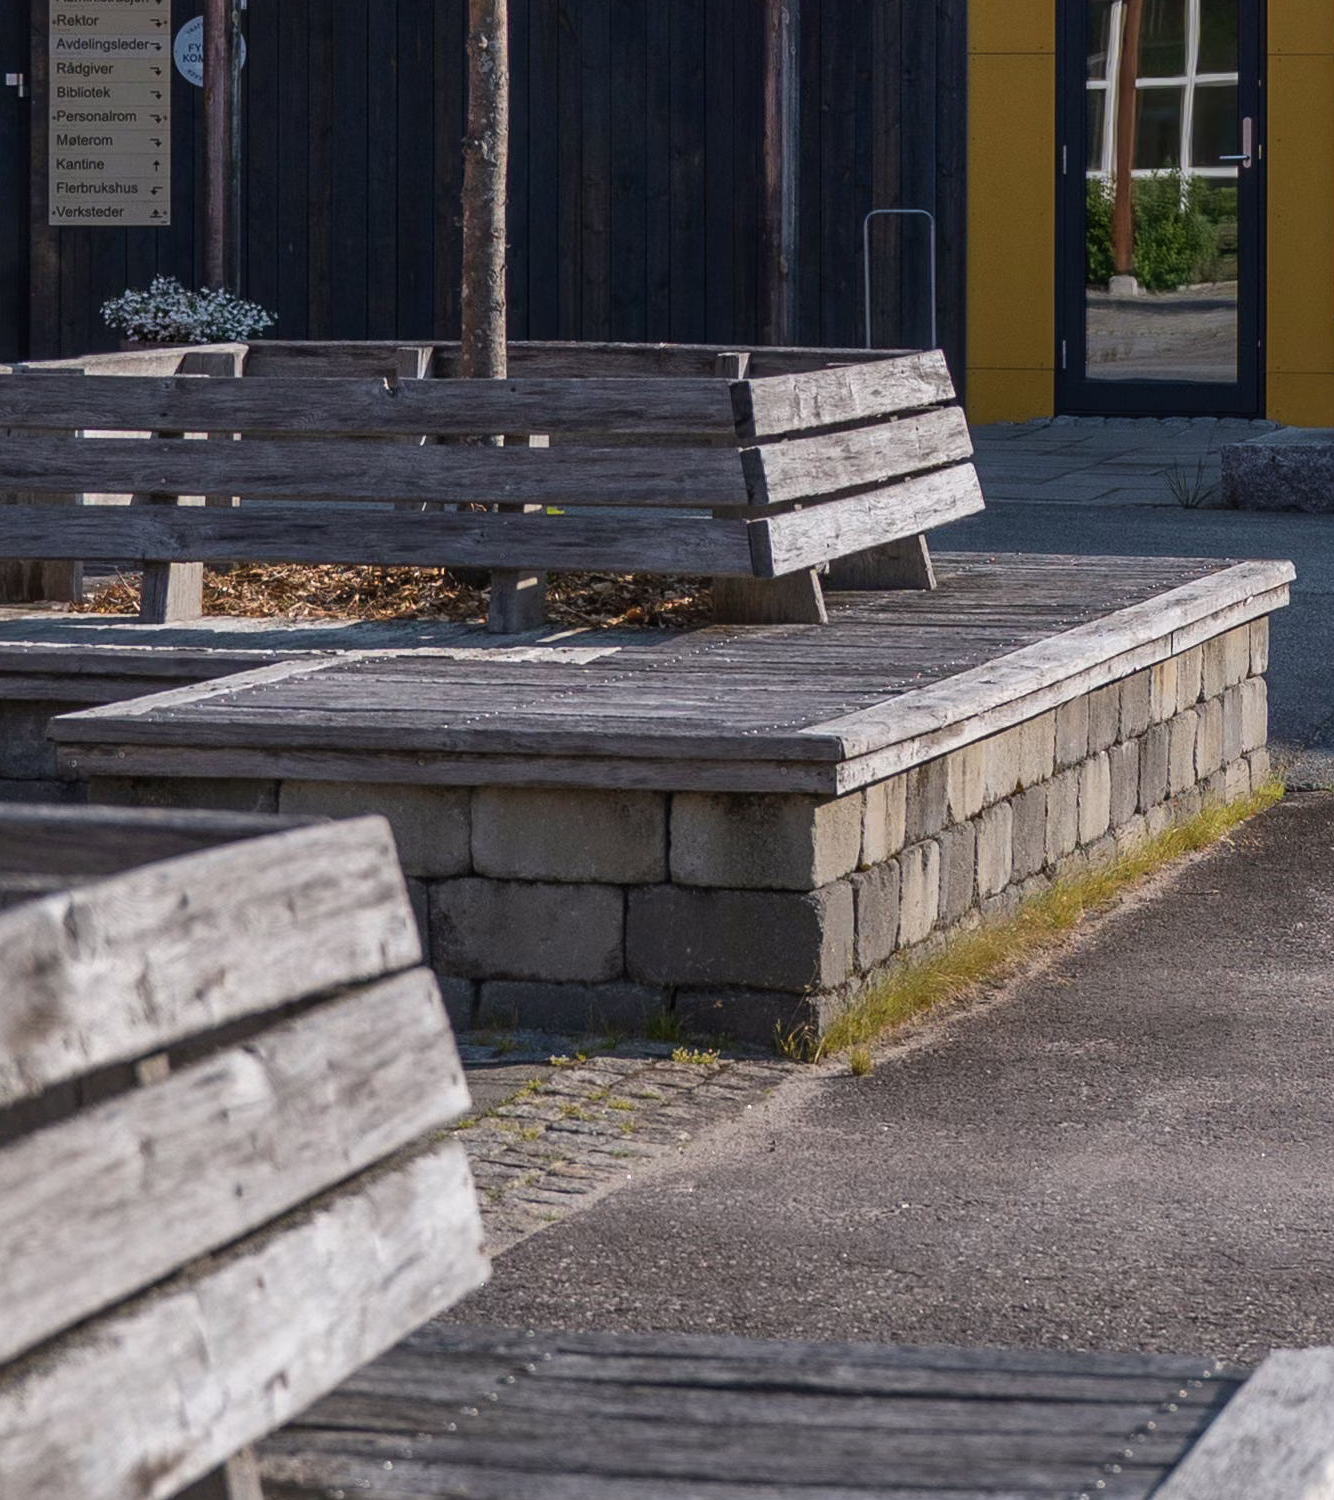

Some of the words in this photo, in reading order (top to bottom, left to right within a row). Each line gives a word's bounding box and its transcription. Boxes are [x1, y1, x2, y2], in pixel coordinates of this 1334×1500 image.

[56, 13, 100, 27] Rektor
[55, 37, 149, 53] Avdelingsleder
[56, 61, 114, 77] Rådgiver
[56, 86, 111, 98] Bibliotek
[56, 110, 138, 122] Personalrom
[56, 134, 114, 146] Møterom
[55, 158, 105, 170] Kantine
[56, 181, 139, 194] Flerbrukshus
[55, 206, 125, 218] Verksteder
